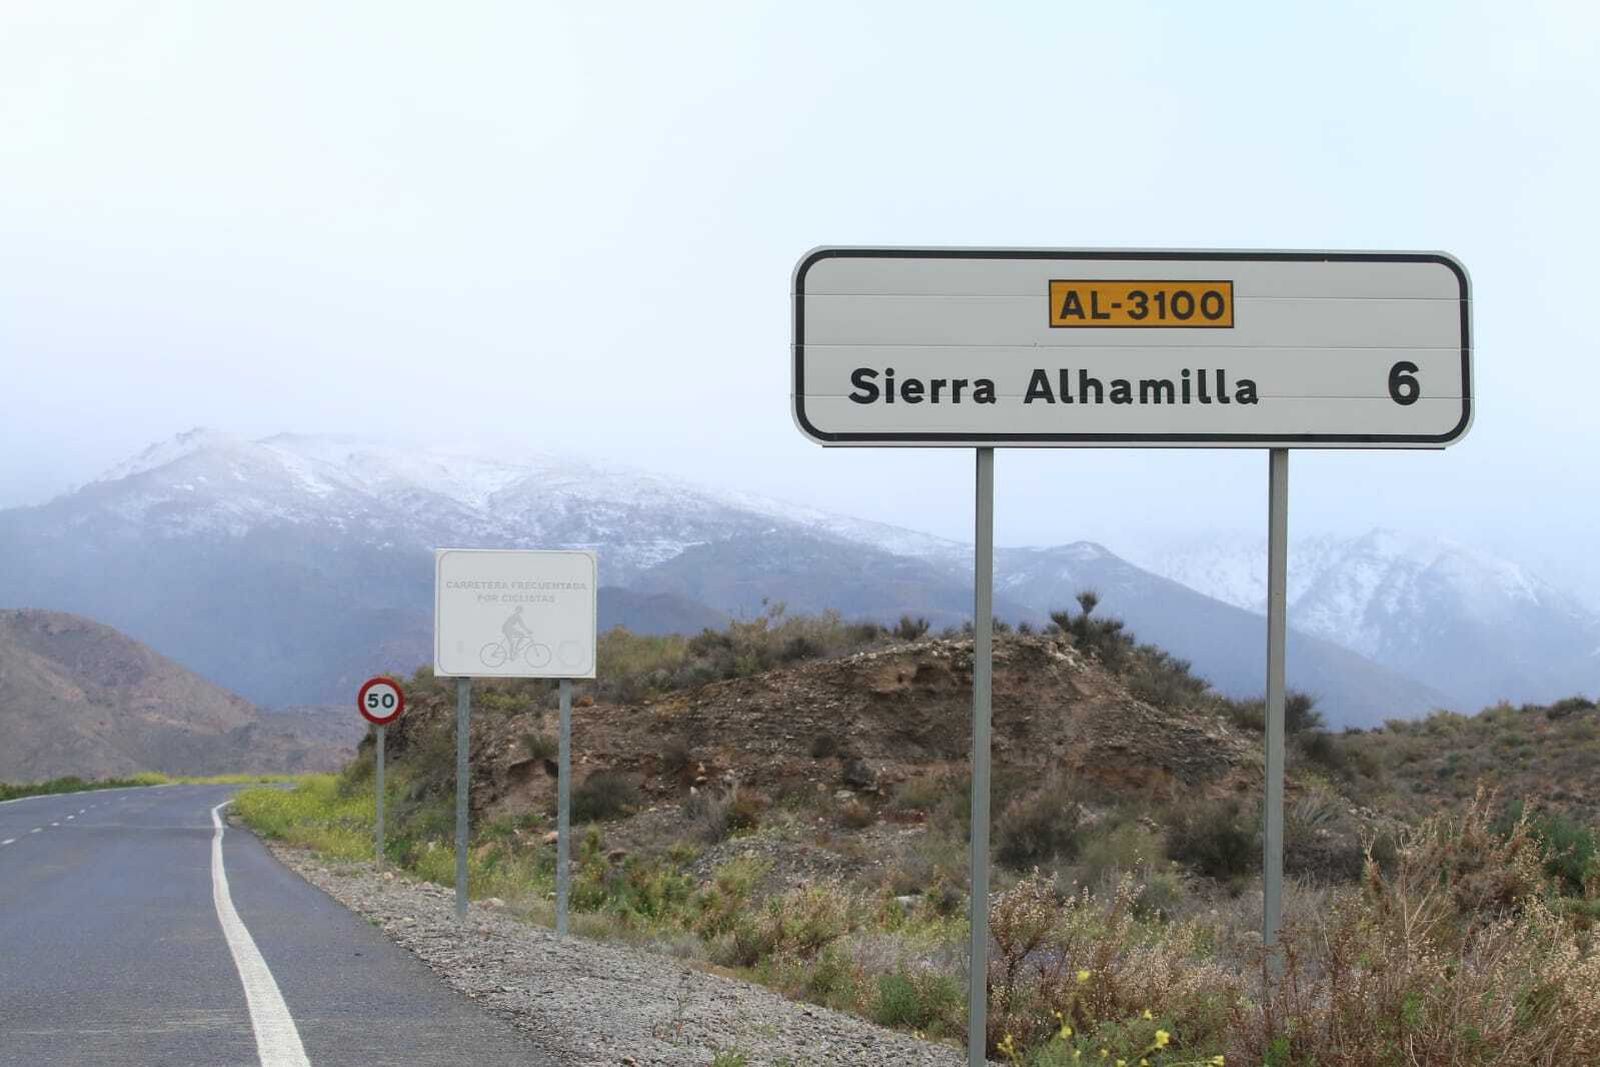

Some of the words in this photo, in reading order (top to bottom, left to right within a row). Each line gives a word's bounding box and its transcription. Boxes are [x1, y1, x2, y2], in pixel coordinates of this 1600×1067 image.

[1059, 290, 1225, 321] AL-3100
[848, 367, 997, 405] Sierra
[1023, 368, 1260, 405] Alhamilla
[1388, 360, 1421, 406] 6
[446, 581, 508, 590] CARRETERA
[511, 581, 587, 590] FRECUENTADA
[367, 693, 395, 709] 50
